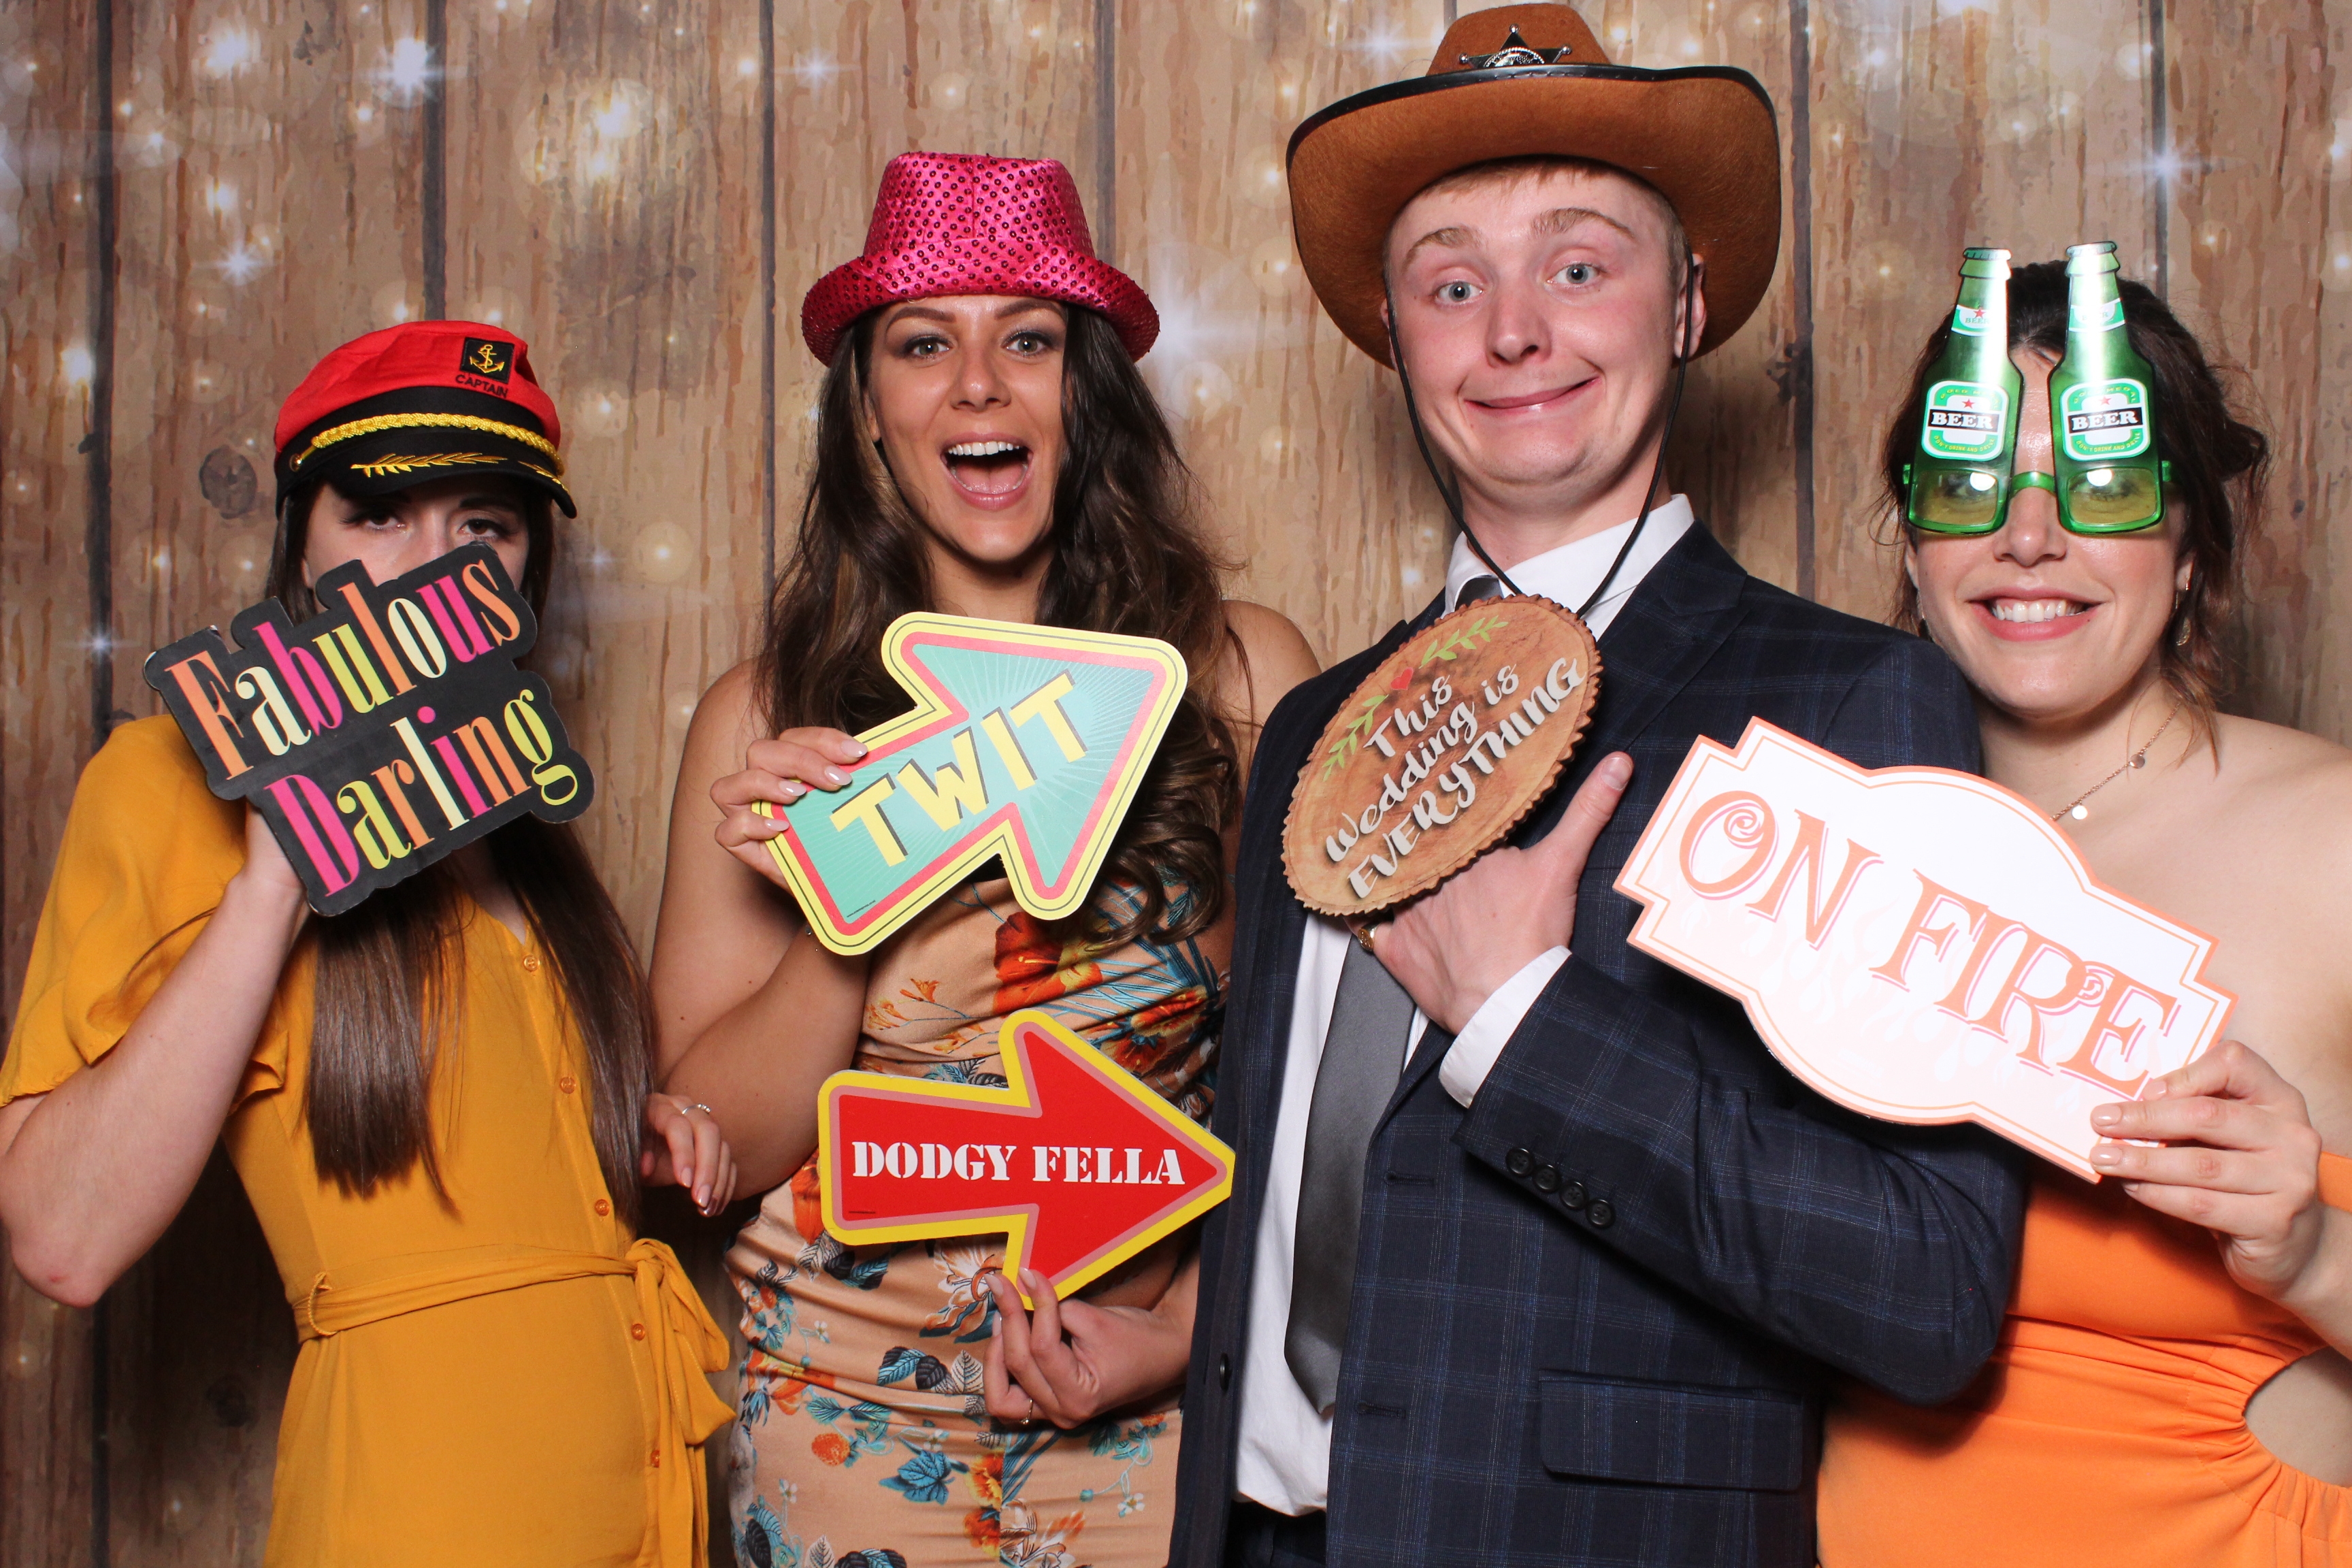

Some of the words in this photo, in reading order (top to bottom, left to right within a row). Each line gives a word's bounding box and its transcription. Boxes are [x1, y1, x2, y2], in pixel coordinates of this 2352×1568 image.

[455, 374, 508, 398] CAPTAIN
[2082, 312, 2109, 321] BR
[1931, 412, 1993, 429] BEER
[2072, 410, 2138, 431] BEER
[165, 559, 521, 781] Fabulous
[1362, 674, 1453, 758] This
[263, 688, 578, 897] Darling
[829, 669, 1089, 866] TWIT
[1326, 701, 1479, 862] Wedding
[1480, 664, 1519, 705] is
[1348, 657, 1586, 898] EVERYTHING
[1679, 790, 1884, 951] ON
[1868, 868, 2181, 1101] FIRE
[852, 1141, 1017, 1181] DODGY
[1032, 1145, 1186, 1185] FELLA
